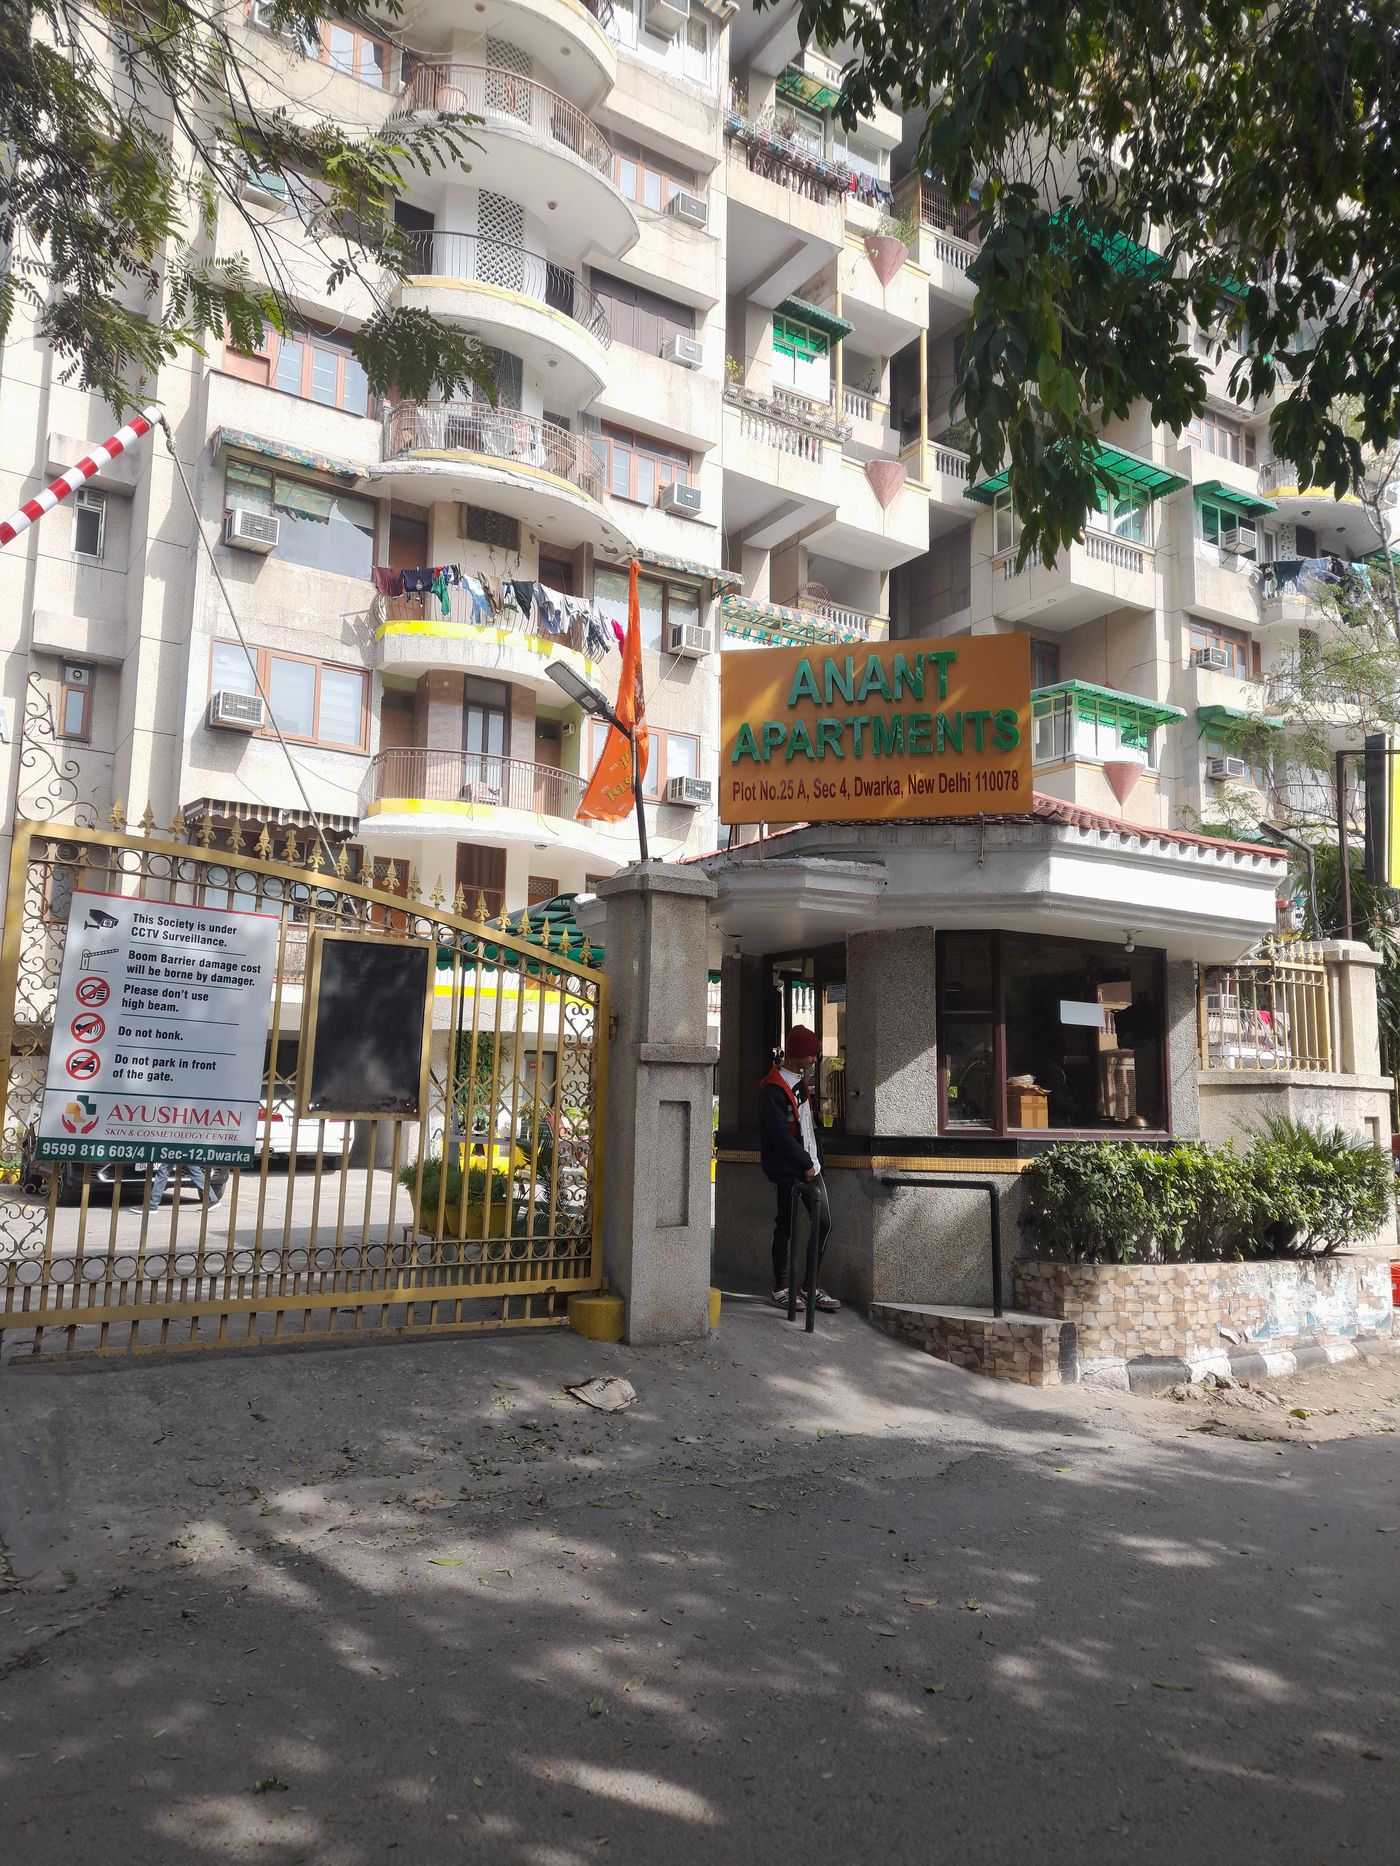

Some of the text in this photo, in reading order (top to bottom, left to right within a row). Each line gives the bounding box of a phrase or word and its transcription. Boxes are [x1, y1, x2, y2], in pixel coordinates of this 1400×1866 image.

[788, 650, 956, 707] ANANT
[731, 709, 1020, 762] APARTMENTS
[733, 770, 1018, 802] Plot No.25 A, Sec 4, Dwarka, New Delhi 110078
[133, 914, 236, 935] This Society is under
[131, 927, 227, 947] CCTV Surveillance.
[129, 951, 261, 973] Boom Barrier damage cost
[127, 964, 255, 986] will be borne by damager.
[124, 984, 208, 1001] Please don't use
[122, 999, 179, 1012] high beam.
[118, 1026, 183, 1040] Do not honk.
[115, 1054, 216, 1070] Do not park in front
[113, 1069, 173, 1082] of the gate.
[107, 1104, 242, 1127] AYUSHMAN
[136, 1130, 203, 1139] COSMETOLOGY
[206, 1132, 239, 1141] CENTRE
[43, 1143, 76, 1155] 9599
[80, 1145, 104, 1156] 816
[109, 1146, 144, 1158] 603/4
